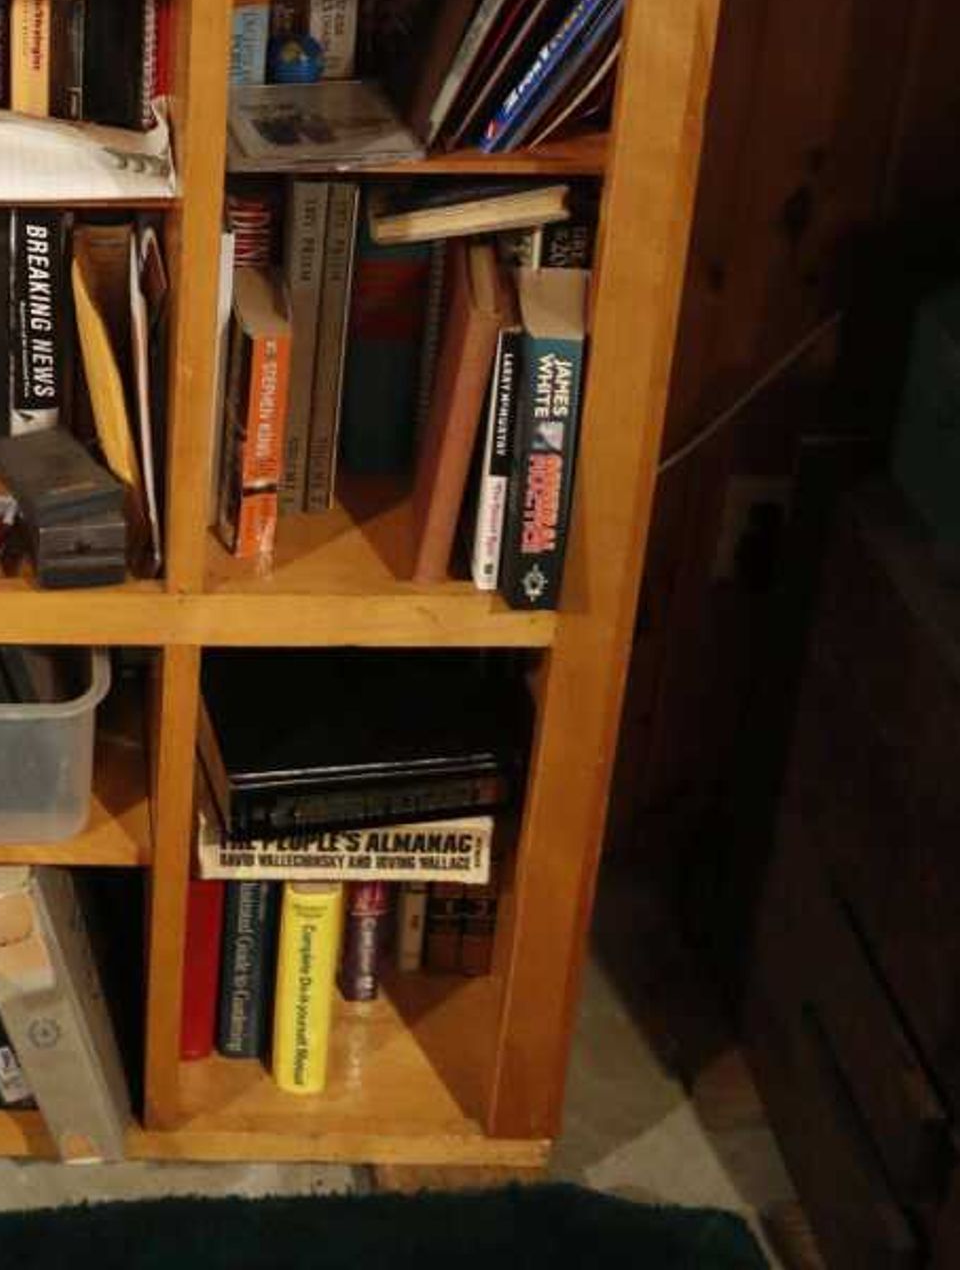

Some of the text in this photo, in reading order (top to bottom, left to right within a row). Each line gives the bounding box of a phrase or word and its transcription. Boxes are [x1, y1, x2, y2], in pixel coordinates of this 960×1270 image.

[25, 224, 55, 397] BREAKING NEWS
[500, 353, 513, 391] LARRY
[534, 353, 554, 418] WHITE
[552, 359, 573, 417] JAMES
[261, 831, 360, 852] PEOPLE'S
[365, 832, 473, 853] ALMANAC
[347, 855, 371, 869] AND
[418, 856, 471, 870] WALLACE
